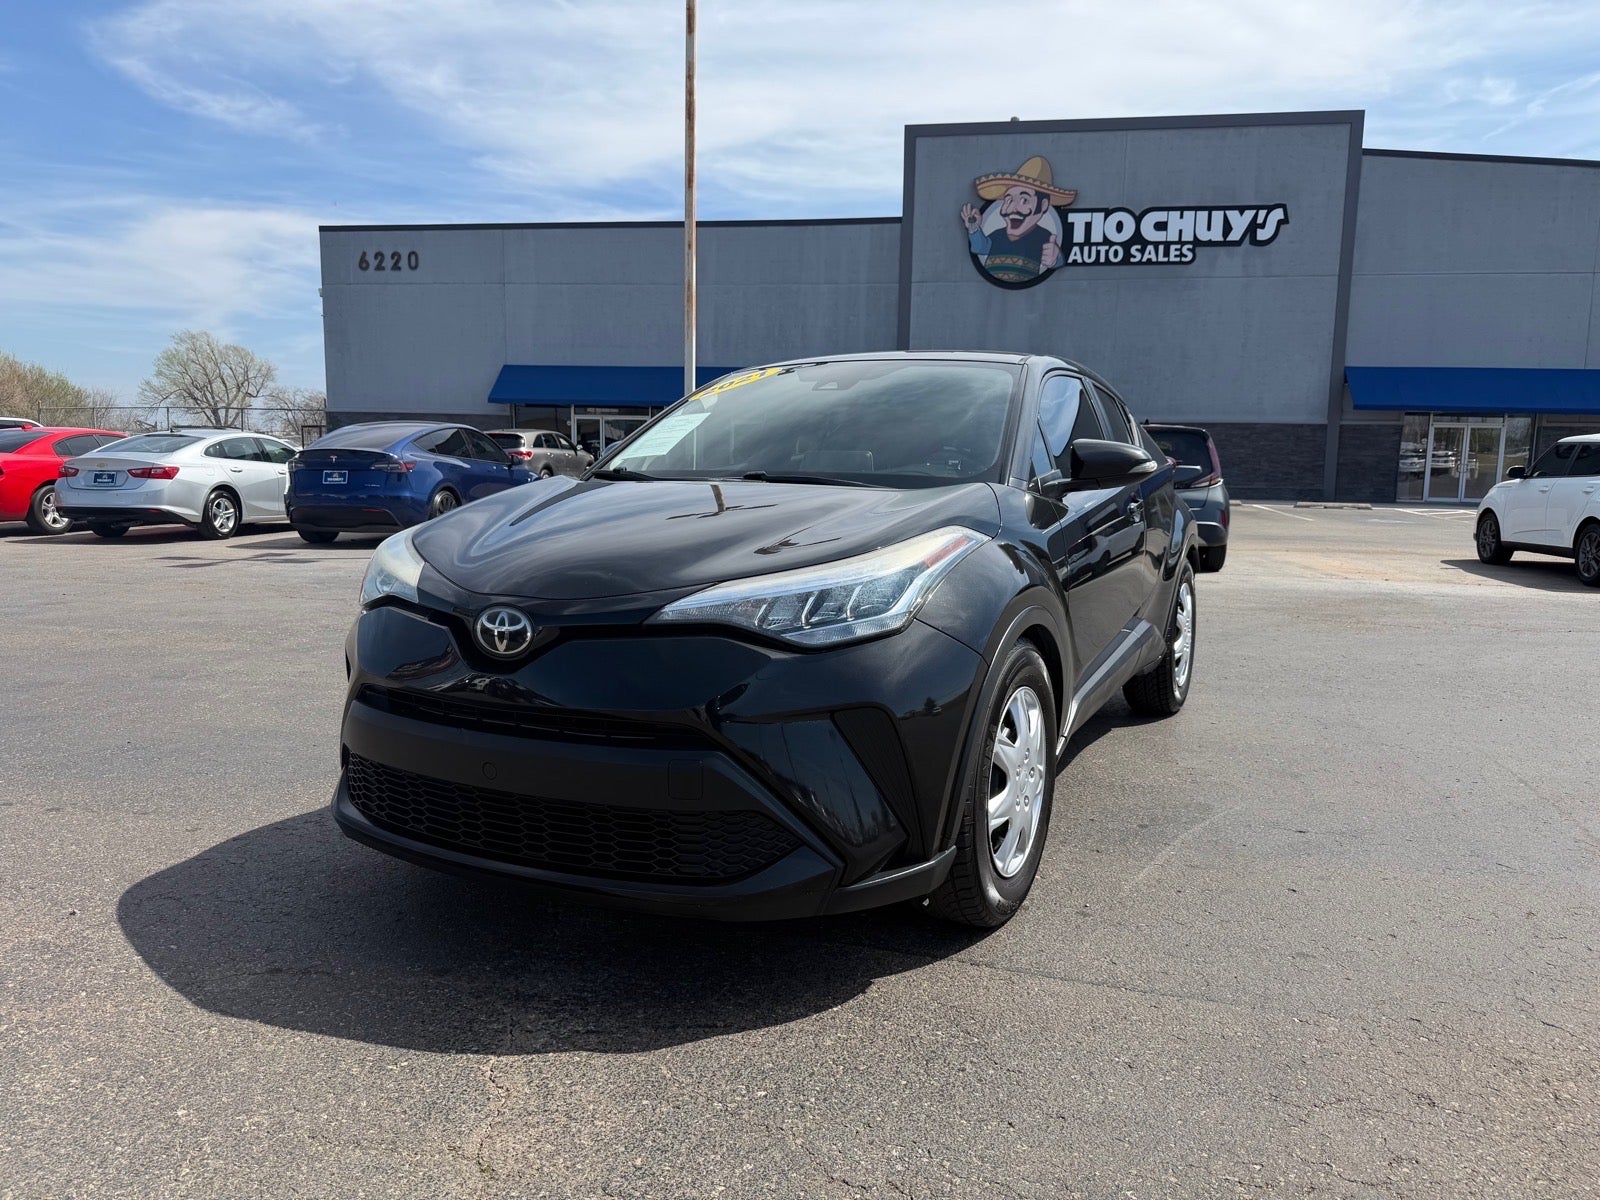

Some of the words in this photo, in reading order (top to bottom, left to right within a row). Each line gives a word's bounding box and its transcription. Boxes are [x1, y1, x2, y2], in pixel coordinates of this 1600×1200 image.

[1067, 210, 1136, 243] TIO
[1139, 207, 1286, 243] CHUY'S
[358, 250, 420, 271] 6220
[1067, 246, 1124, 264] AUTO
[1129, 244, 1194, 263] SALES
